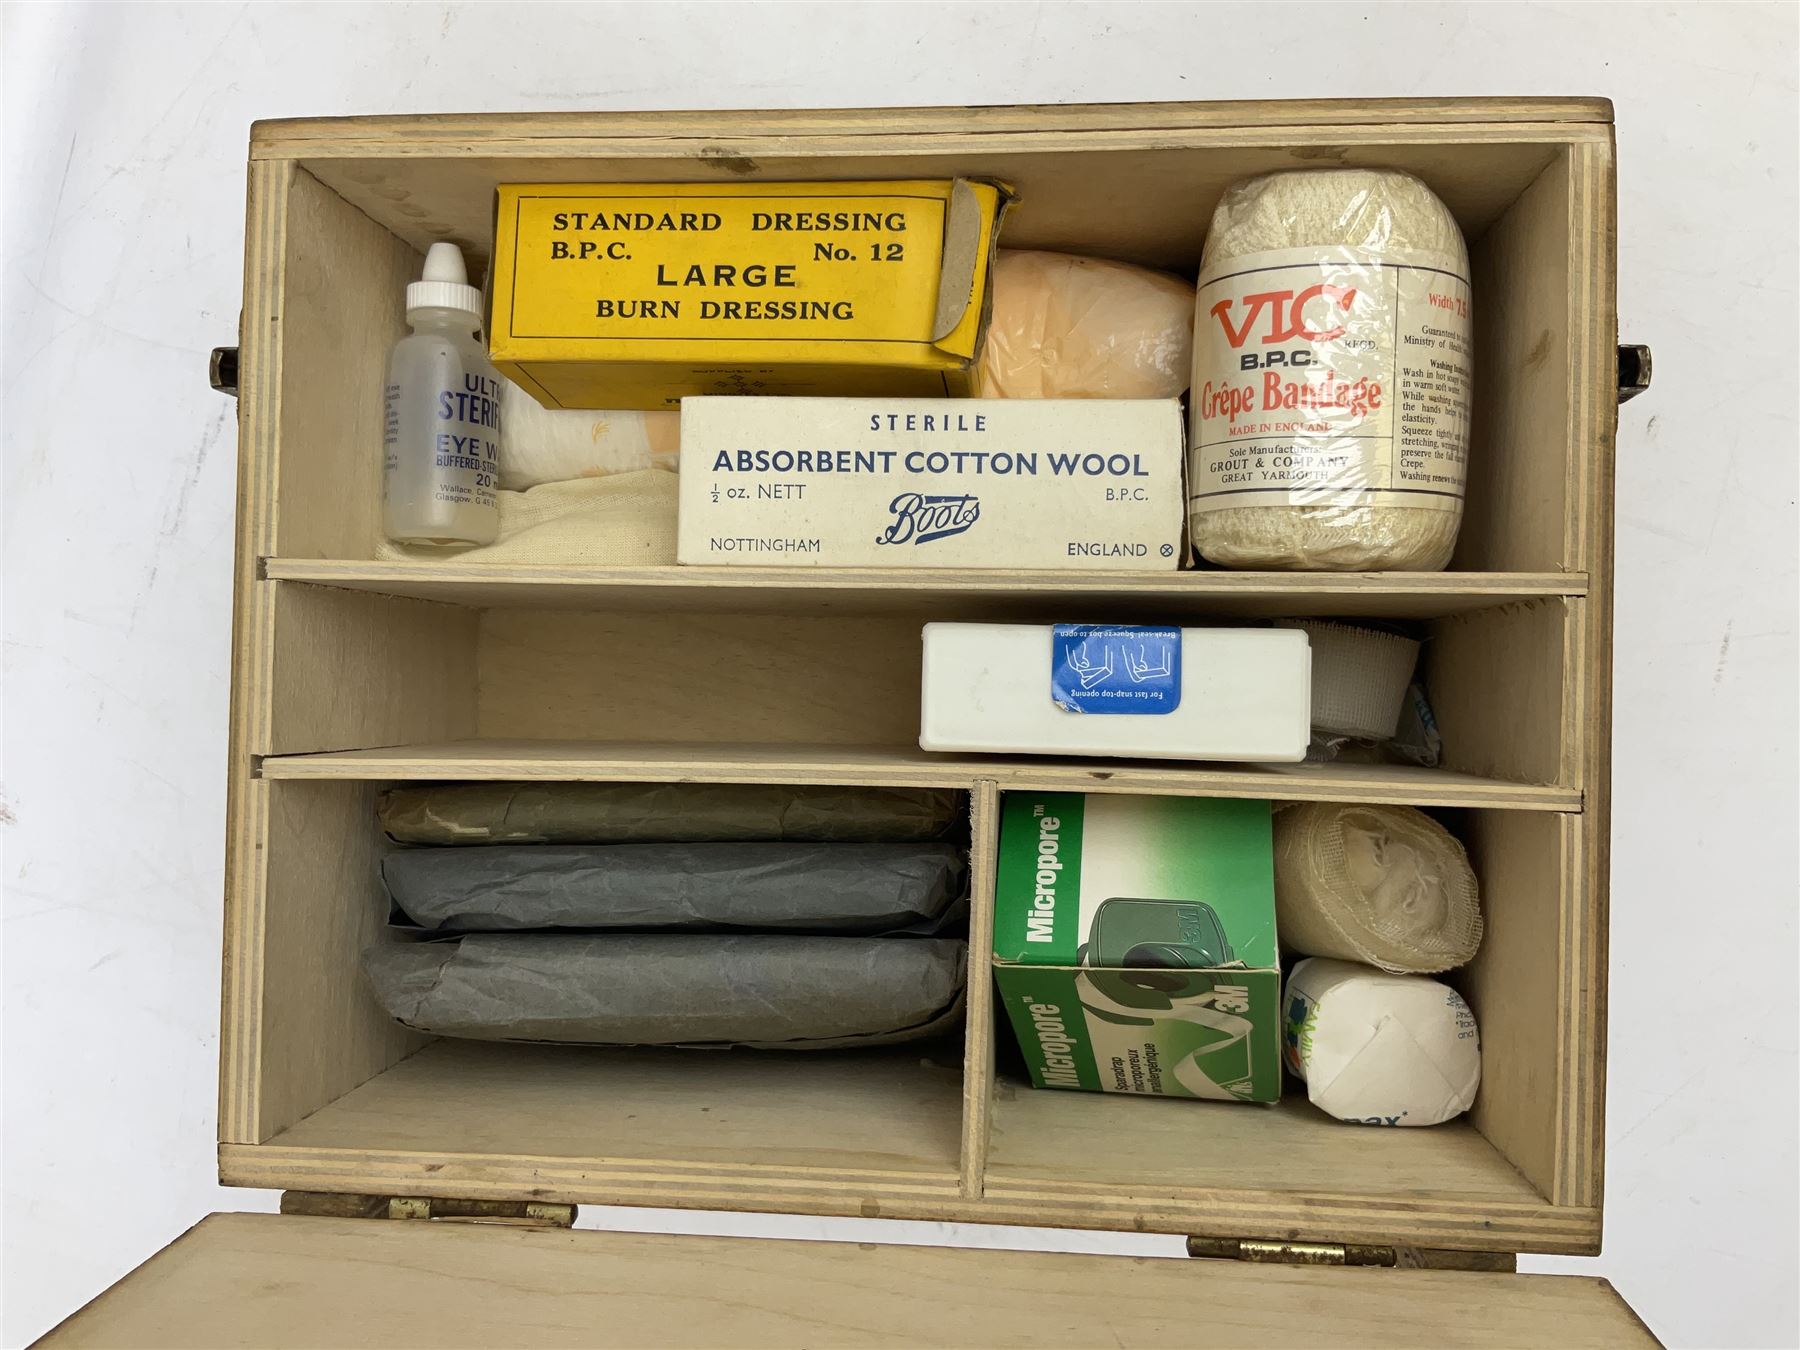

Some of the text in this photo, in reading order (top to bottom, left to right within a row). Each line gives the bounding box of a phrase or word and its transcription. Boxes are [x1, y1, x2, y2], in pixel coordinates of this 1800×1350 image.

[552, 212, 907, 232] STANDARD DRESSING
[551, 241, 632, 261] B.P.C.
[813, 242, 905, 263] No. 12
[656, 264, 798, 288] LARGE
[1427, 293, 1454, 311] Width
[595, 299, 854, 321] BURN DRESSING
[1209, 283, 1357, 349] VIC
[1404, 335, 1435, 348] Ministry
[1438, 340, 1446, 349] of
[1240, 350, 1319, 371] B.P.C.
[1403, 368, 1424, 378] Wash
[1402, 379, 1411, 388] in
[1413, 381, 1434, 390] warm
[1201, 369, 1382, 424] Crêpe Bandage
[1402, 391, 1425, 401] While
[1403, 402, 1416, 411] the
[1421, 403, 1442, 414] hands
[870, 414, 988, 433] STERILE
[1401, 413, 1437, 425] elasticity.
[1229, 424, 1257, 437] MADE
[1259, 423, 1271, 433] IN
[1401, 425, 1433, 437] Squeeze
[436, 434, 480, 456] EYE
[1229, 448, 1247, 458] Sole
[1400, 450, 1432, 459] preserve
[712, 449, 1150, 477] ABSORBENT COTTON WOOL
[1209, 457, 1249, 474] GROUT
[1255, 458, 1265, 468] &
[476, 473, 491, 488] 20
[1221, 472, 1254, 484] GREAT
[1400, 471, 1431, 483] Washing
[727, 486, 750, 500] oz.
[758, 484, 807, 500] NETT
[1106, 488, 1149, 502] B.P.C.
[875, 492, 981, 546] Boots
[710, 537, 821, 553] NOTTINGHAM
[1067, 542, 1148, 557] ENGLAND
[1060, 630, 1078, 638] open
[1089, 630, 1102, 638] box
[1071, 688, 1163, 700] For fast snap-top opening
[1213, 985, 1250, 1013] 3M
[1458, 1030, 1474, 1040] and
[1111, 1056, 1129, 1092] Sparadrap
